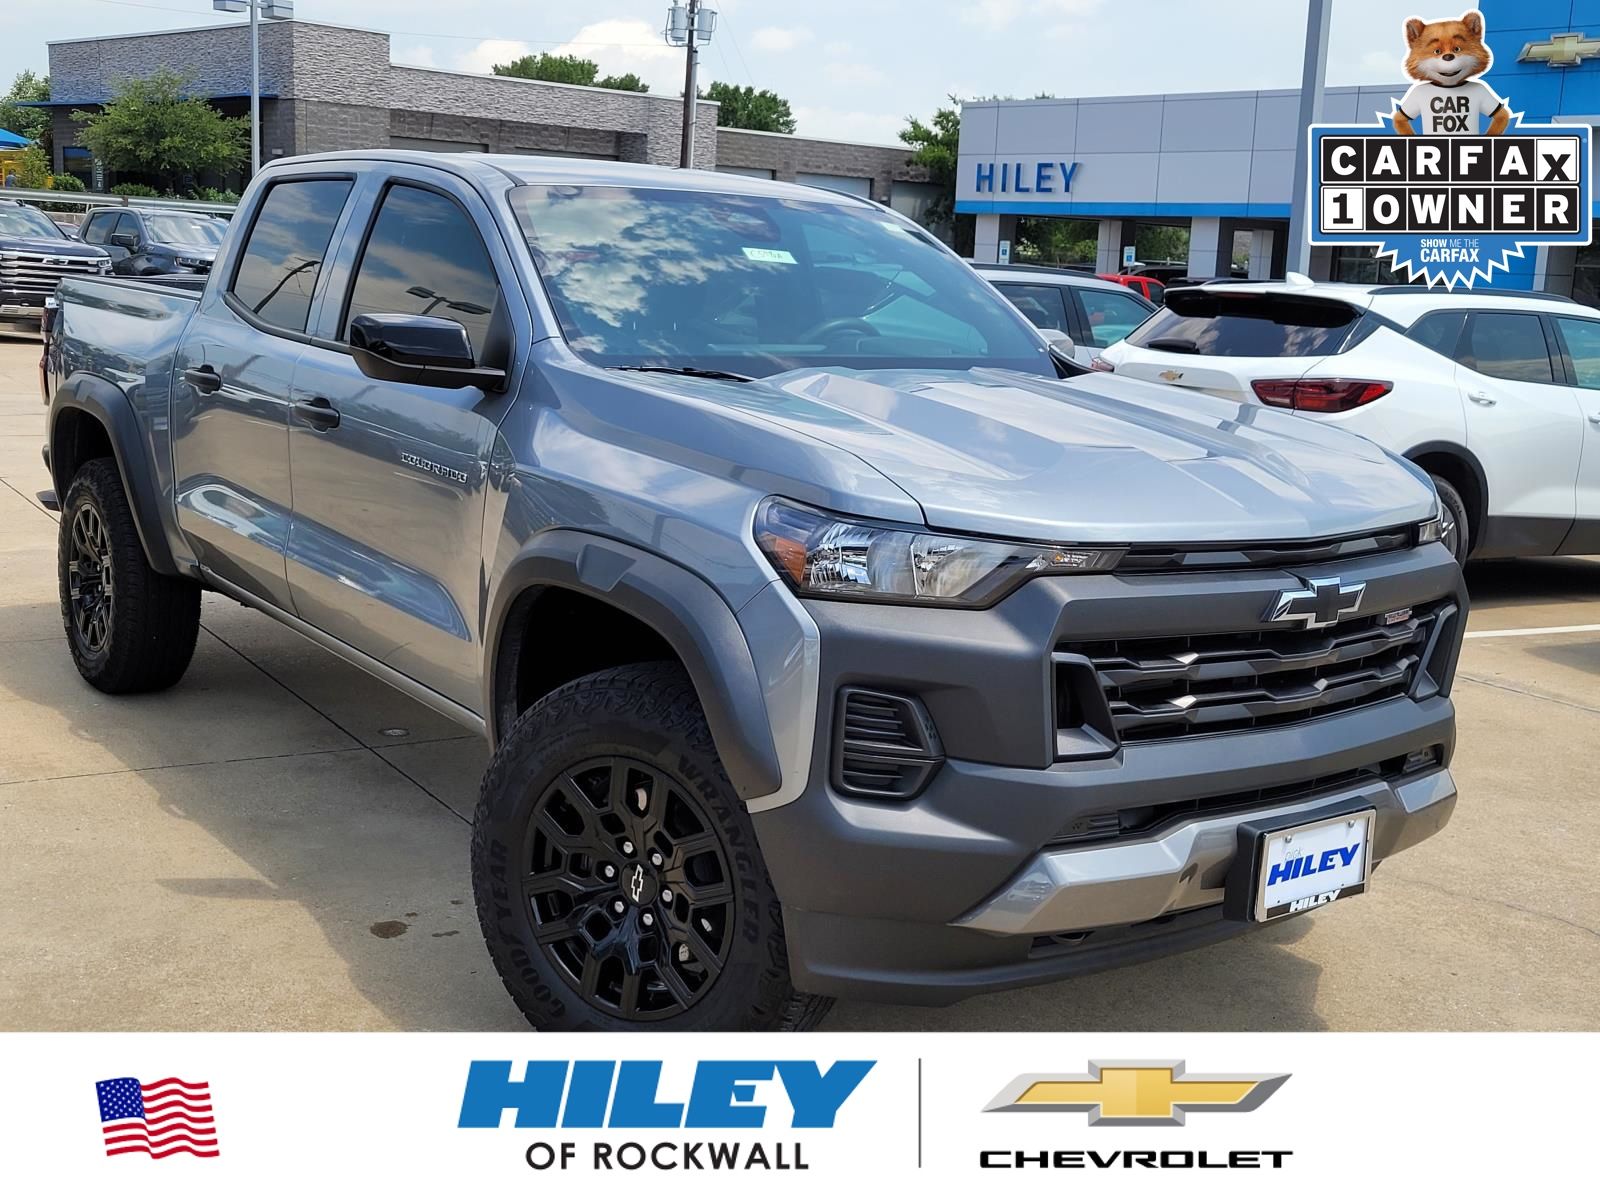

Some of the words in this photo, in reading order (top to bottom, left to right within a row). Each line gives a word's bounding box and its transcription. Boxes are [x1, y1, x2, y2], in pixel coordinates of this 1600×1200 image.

[976, 162, 1080, 193] HILEY
[1266, 842, 1361, 887] HILEY
[1289, 889, 1341, 913] HILEY
